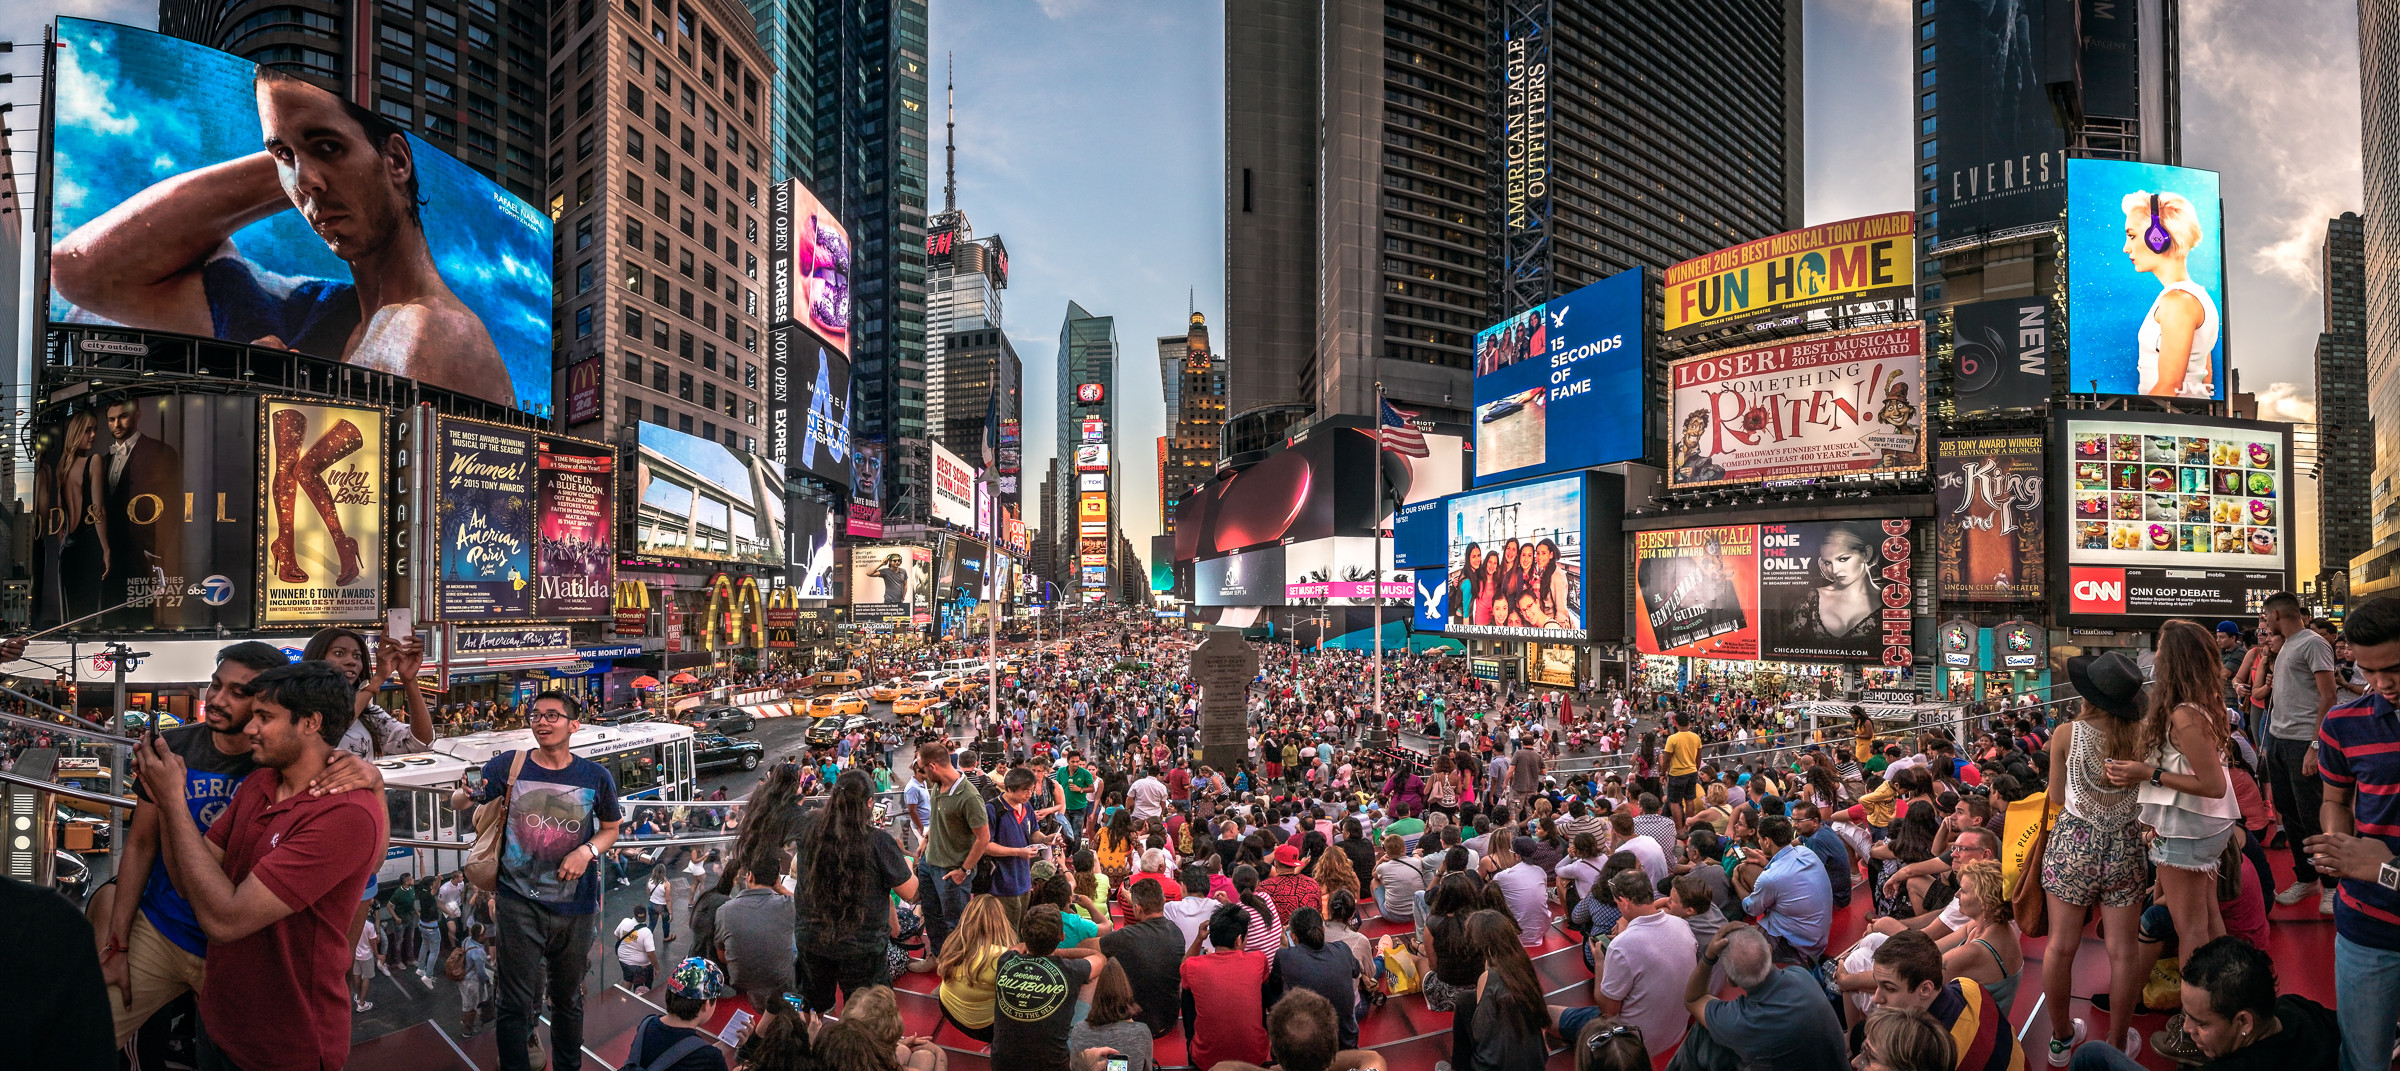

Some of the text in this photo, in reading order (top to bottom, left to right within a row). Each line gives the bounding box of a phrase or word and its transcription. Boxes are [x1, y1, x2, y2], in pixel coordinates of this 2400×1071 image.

[1507, 37, 1525, 230] AMERICAN EAGLE
[1528, 62, 1546, 198] OUTFITTERS
[1953, 149, 2065, 201] EVEREST
[494, 192, 544, 230] RAFAEL NADAL
[775, 181, 788, 324] NOW OPEN EXPRESS
[1667, 214, 1910, 286] WINNER! 2015 BEST MUSICAL TONY AWARD
[1680, 240, 1893, 324] FUN HOME
[87, 342, 143, 352] city outdoor
[1551, 336, 1565, 352] 15
[2019, 305, 2045, 376] NEW
[1551, 334, 1622, 369] SECONDS
[1679, 332, 1910, 386] LOSER! BEST MUSICAL!
[1791, 344, 1910, 367] 2015 TONY AWARD
[1551, 367, 1571, 384] OF
[1721, 363, 1861, 394] SOMETHING
[573, 388, 595, 401] OPEN
[1551, 378, 1591, 402] FAME
[576, 396, 591, 411] 24
[775, 331, 787, 469] NOW OPEN EXPRES
[571, 406, 597, 420] HOURS
[449, 430, 526, 449] THE MOST AWARD-WINNING
[452, 439, 478, 449] MUSICAL
[488, 443, 499, 452] THE
[500, 445, 524, 456] SEASON!
[807, 428, 842, 452] FASHION
[1782, 445, 1822, 454] FUNNIEST
[1822, 442, 1859, 450] MUSICAL
[1939, 437, 2042, 451] 2015 TONY AWARD WINNER!
[448, 451, 527, 481] Winner!
[1721, 459, 1751, 468] COMEDY
[1763, 456, 1773, 464] AT
[1774, 455, 1797, 463] LEAST
[1799, 453, 1815, 461] 400
[449, 475, 525, 493] 4 2015 TONY AWARDS
[547, 480, 604, 495] A BLUE MOON.
[1938, 459, 2043, 514] The King
[333, 487, 377, 505] Boots
[396, 421, 409, 577] PALACE
[1406, 501, 1438, 514] OUR SWEET
[469, 507, 487, 531] An
[456, 522, 521, 555] American
[1638, 527, 1752, 549] BEST MUSICAL!
[1763, 525, 1787, 534] THE
[1763, 534, 1800, 548] ONE
[466, 545, 508, 567] Paris
[1639, 545, 1752, 559] 2014 TONY AWARD WINNER
[1763, 548, 1787, 557] THE
[1763, 557, 1811, 570] ONLY
[269, 588, 375, 599] WINNER! 6 TONY AWARDS
[538, 574, 610, 600] Matilda
[1289, 585, 1329, 595] SET MUSIC FREE
[1356, 585, 1414, 595] SET MUSIC
[1881, 519, 1912, 667] CHICAGO
[2073, 581, 2122, 602] CNN
[2130, 587, 2220, 598] CNN GOP DEBATE
[126, 595, 184, 608] SEPT 27
[1674, 603, 1707, 622] GUIDE
[463, 634, 476, 648] An
[478, 633, 521, 650] American
[523, 631, 545, 646] Paris
[1445, 624, 1586, 640] AMERICAN EAGLE OUTFITTERS
[575, 650, 597, 658] ANGE
[598, 649, 623, 657] MONEY
[1773, 647, 1868, 656] CHICAGOTHEMUSICAL.COM
[1710, 661, 1822, 675] GRAND SLAM
[1875, 691, 1891, 701] HOT
[1892, 692, 1914, 701] DOGS
[1920, 712, 1954, 724] snack
[613, 742, 627, 750] Hybrid
[628, 739, 645, 747] Electric
[516, 810, 580, 833] TOKYO
[997, 974, 1065, 994] BILLABONG
[1013, 972, 1043, 982] ORIGINAL
[1041, 1005, 1055, 1017] SEA
